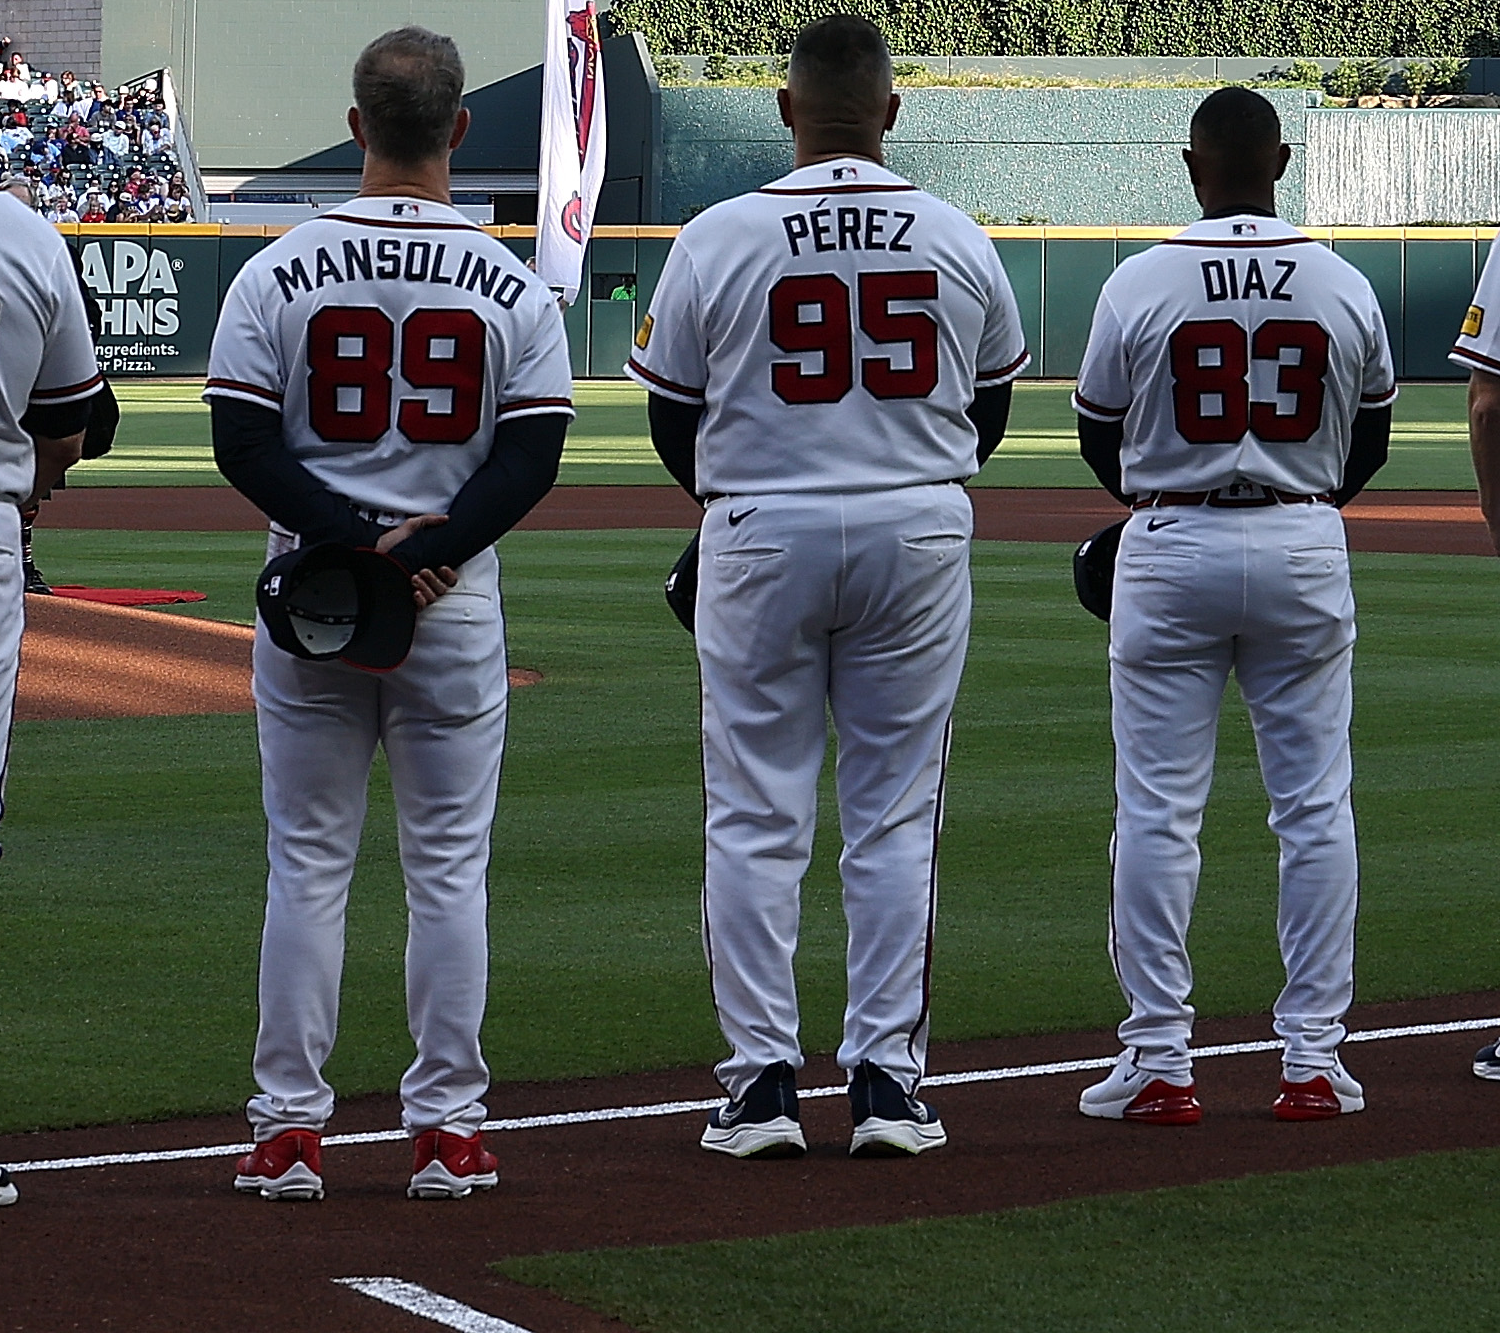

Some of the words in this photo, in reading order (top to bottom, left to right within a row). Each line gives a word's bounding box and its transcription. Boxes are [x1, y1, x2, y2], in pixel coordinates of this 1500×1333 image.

[781, 197, 916, 257] PÉREZ
[81, 240, 179, 294] APA
[271, 238, 527, 310] MANSOLINO
[1200, 258, 1297, 303] DIAZ
[94, 298, 180, 336] HNS
[767, 269, 939, 405] 95
[94, 342, 180, 359] ngredients.
[113, 358, 156, 371] Pizza.
[306, 304, 488, 446] 89
[1168, 317, 1331, 445] 83
